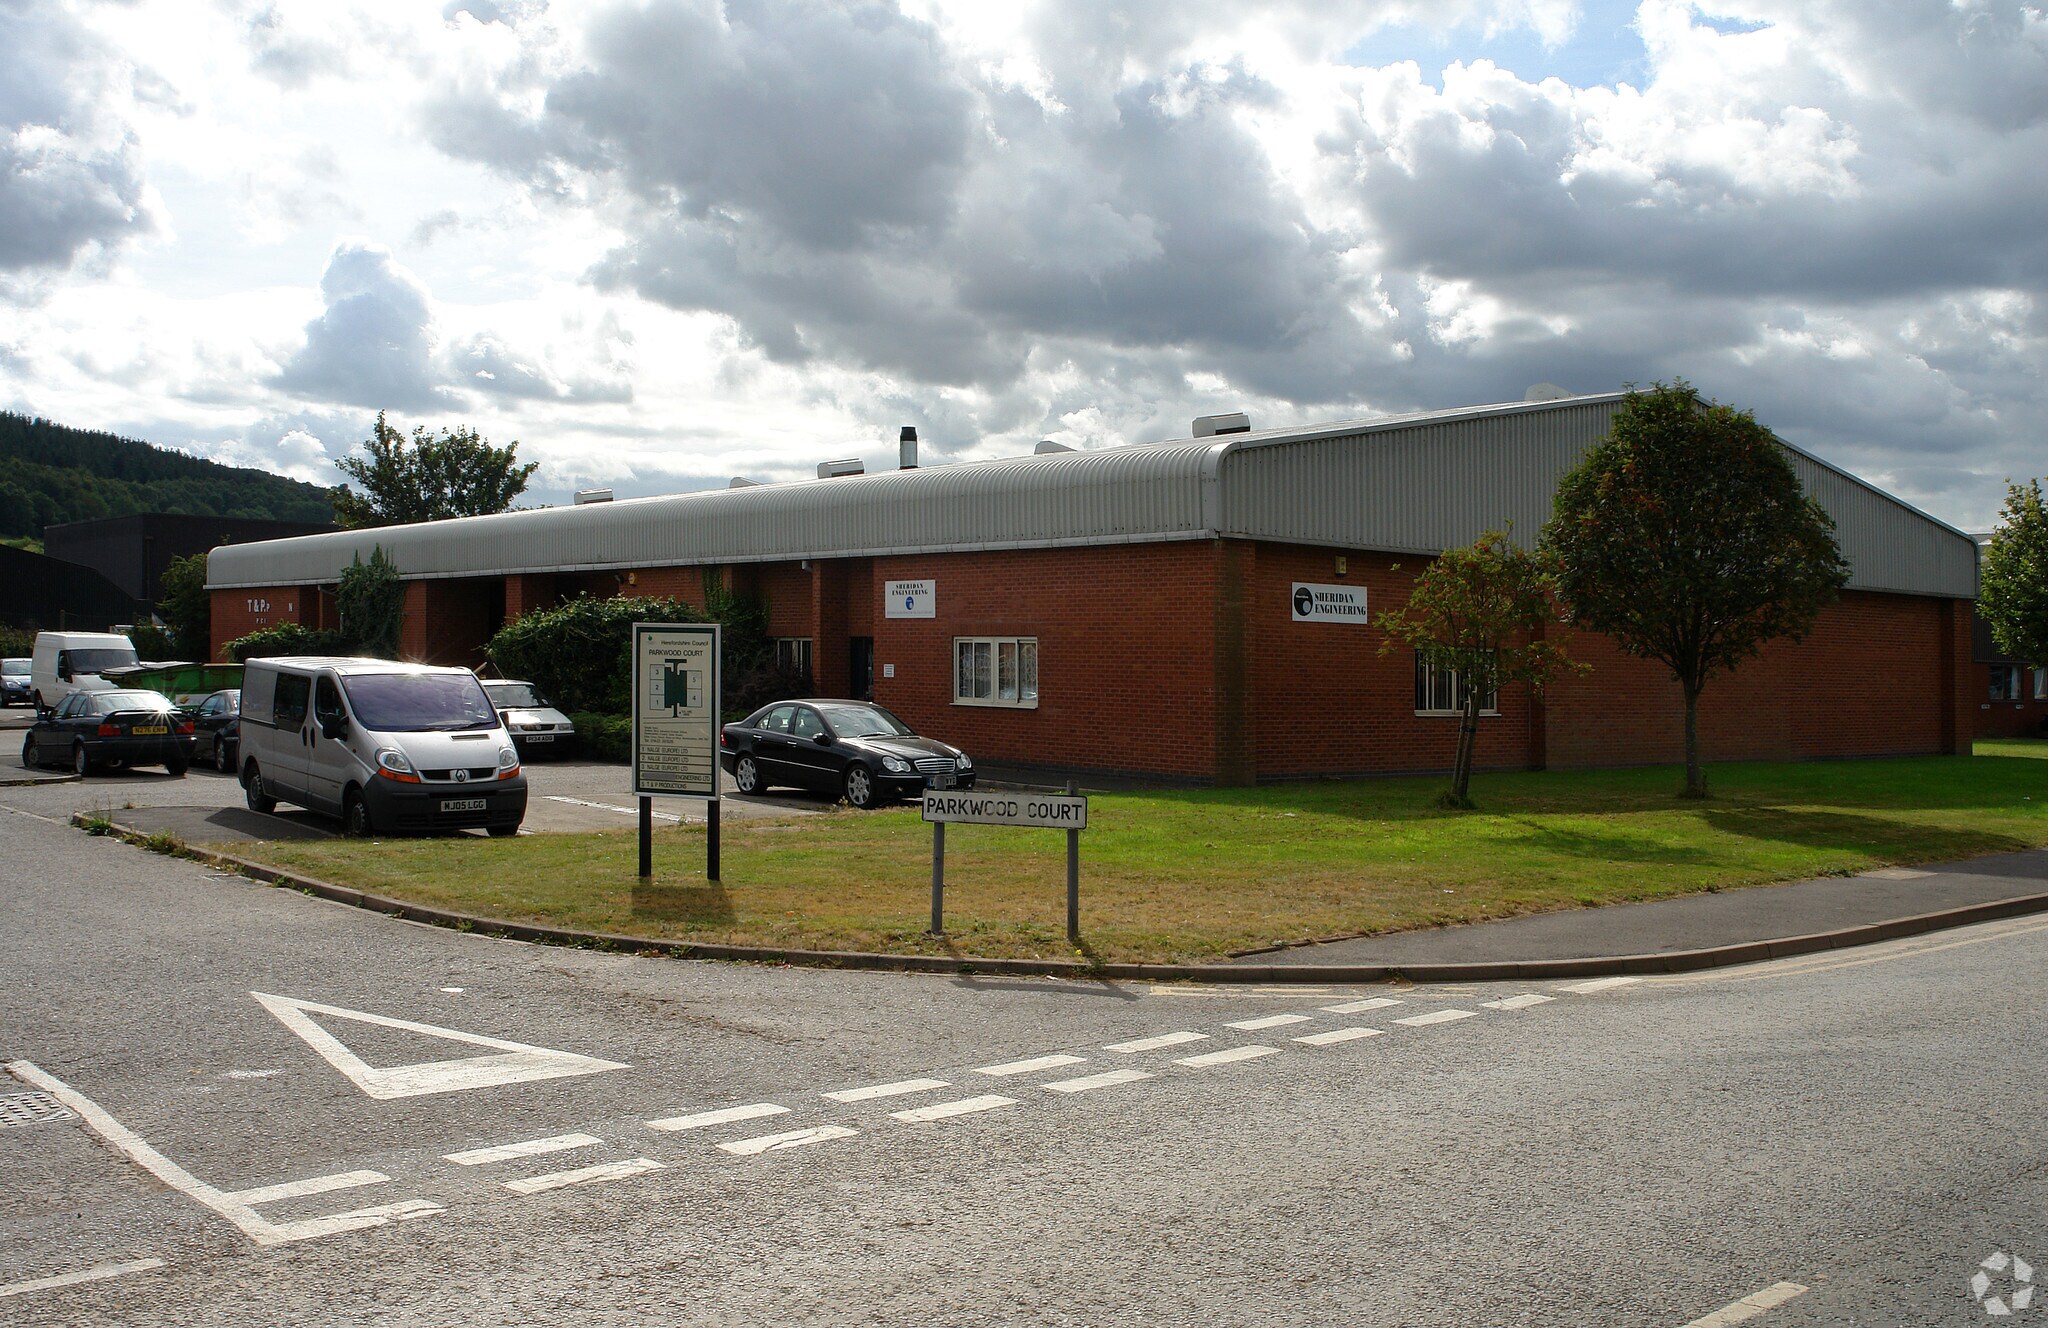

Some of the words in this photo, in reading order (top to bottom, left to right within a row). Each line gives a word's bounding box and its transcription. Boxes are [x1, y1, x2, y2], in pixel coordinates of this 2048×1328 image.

[1314, 592, 1354, 603] SHERIDAN
[1314, 604, 1366, 615] ENGINEERING
[467, 801, 484, 809] LGG
[926, 797, 1018, 818] PARKWOOD
[1027, 802, 1083, 821] COURT
